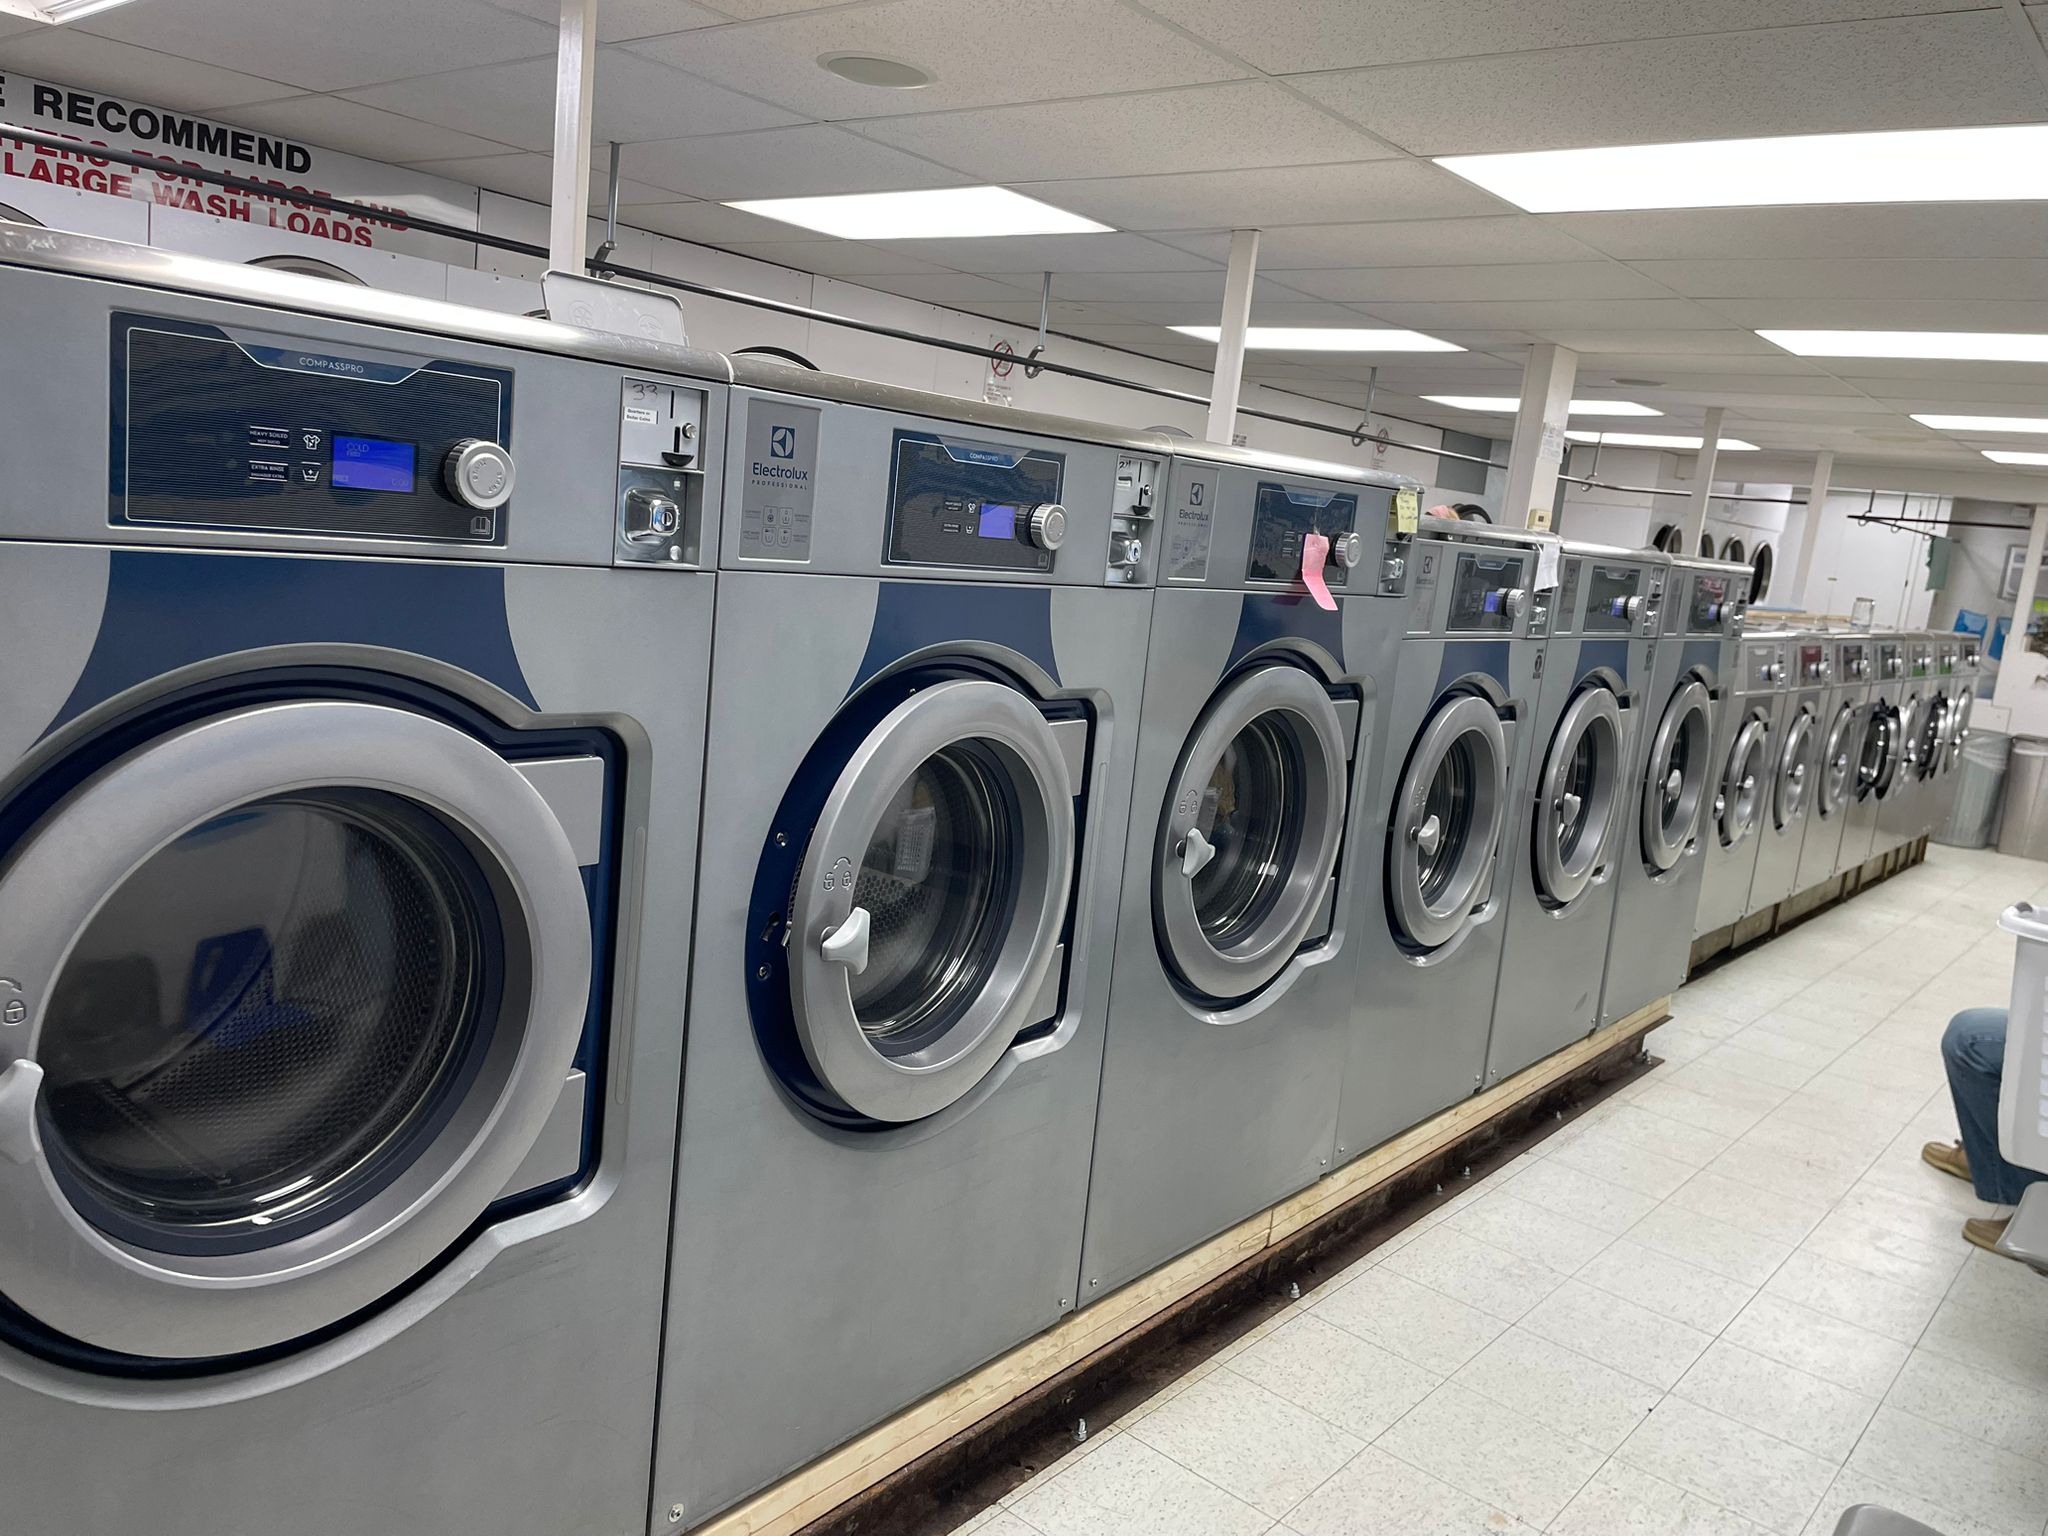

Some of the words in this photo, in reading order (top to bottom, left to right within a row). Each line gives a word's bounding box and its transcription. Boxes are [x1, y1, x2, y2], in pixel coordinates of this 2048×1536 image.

[34, 84, 312, 174] RECOMMEND
[5, 152, 133, 199] LARGE
[152, 181, 250, 222] WASH
[269, 207, 373, 248] LOADS
[299, 357, 364, 374] COMPASSPRO
[752, 462, 808, 481] Electrolux
[751, 480, 808, 491] PROFESSIONAL
